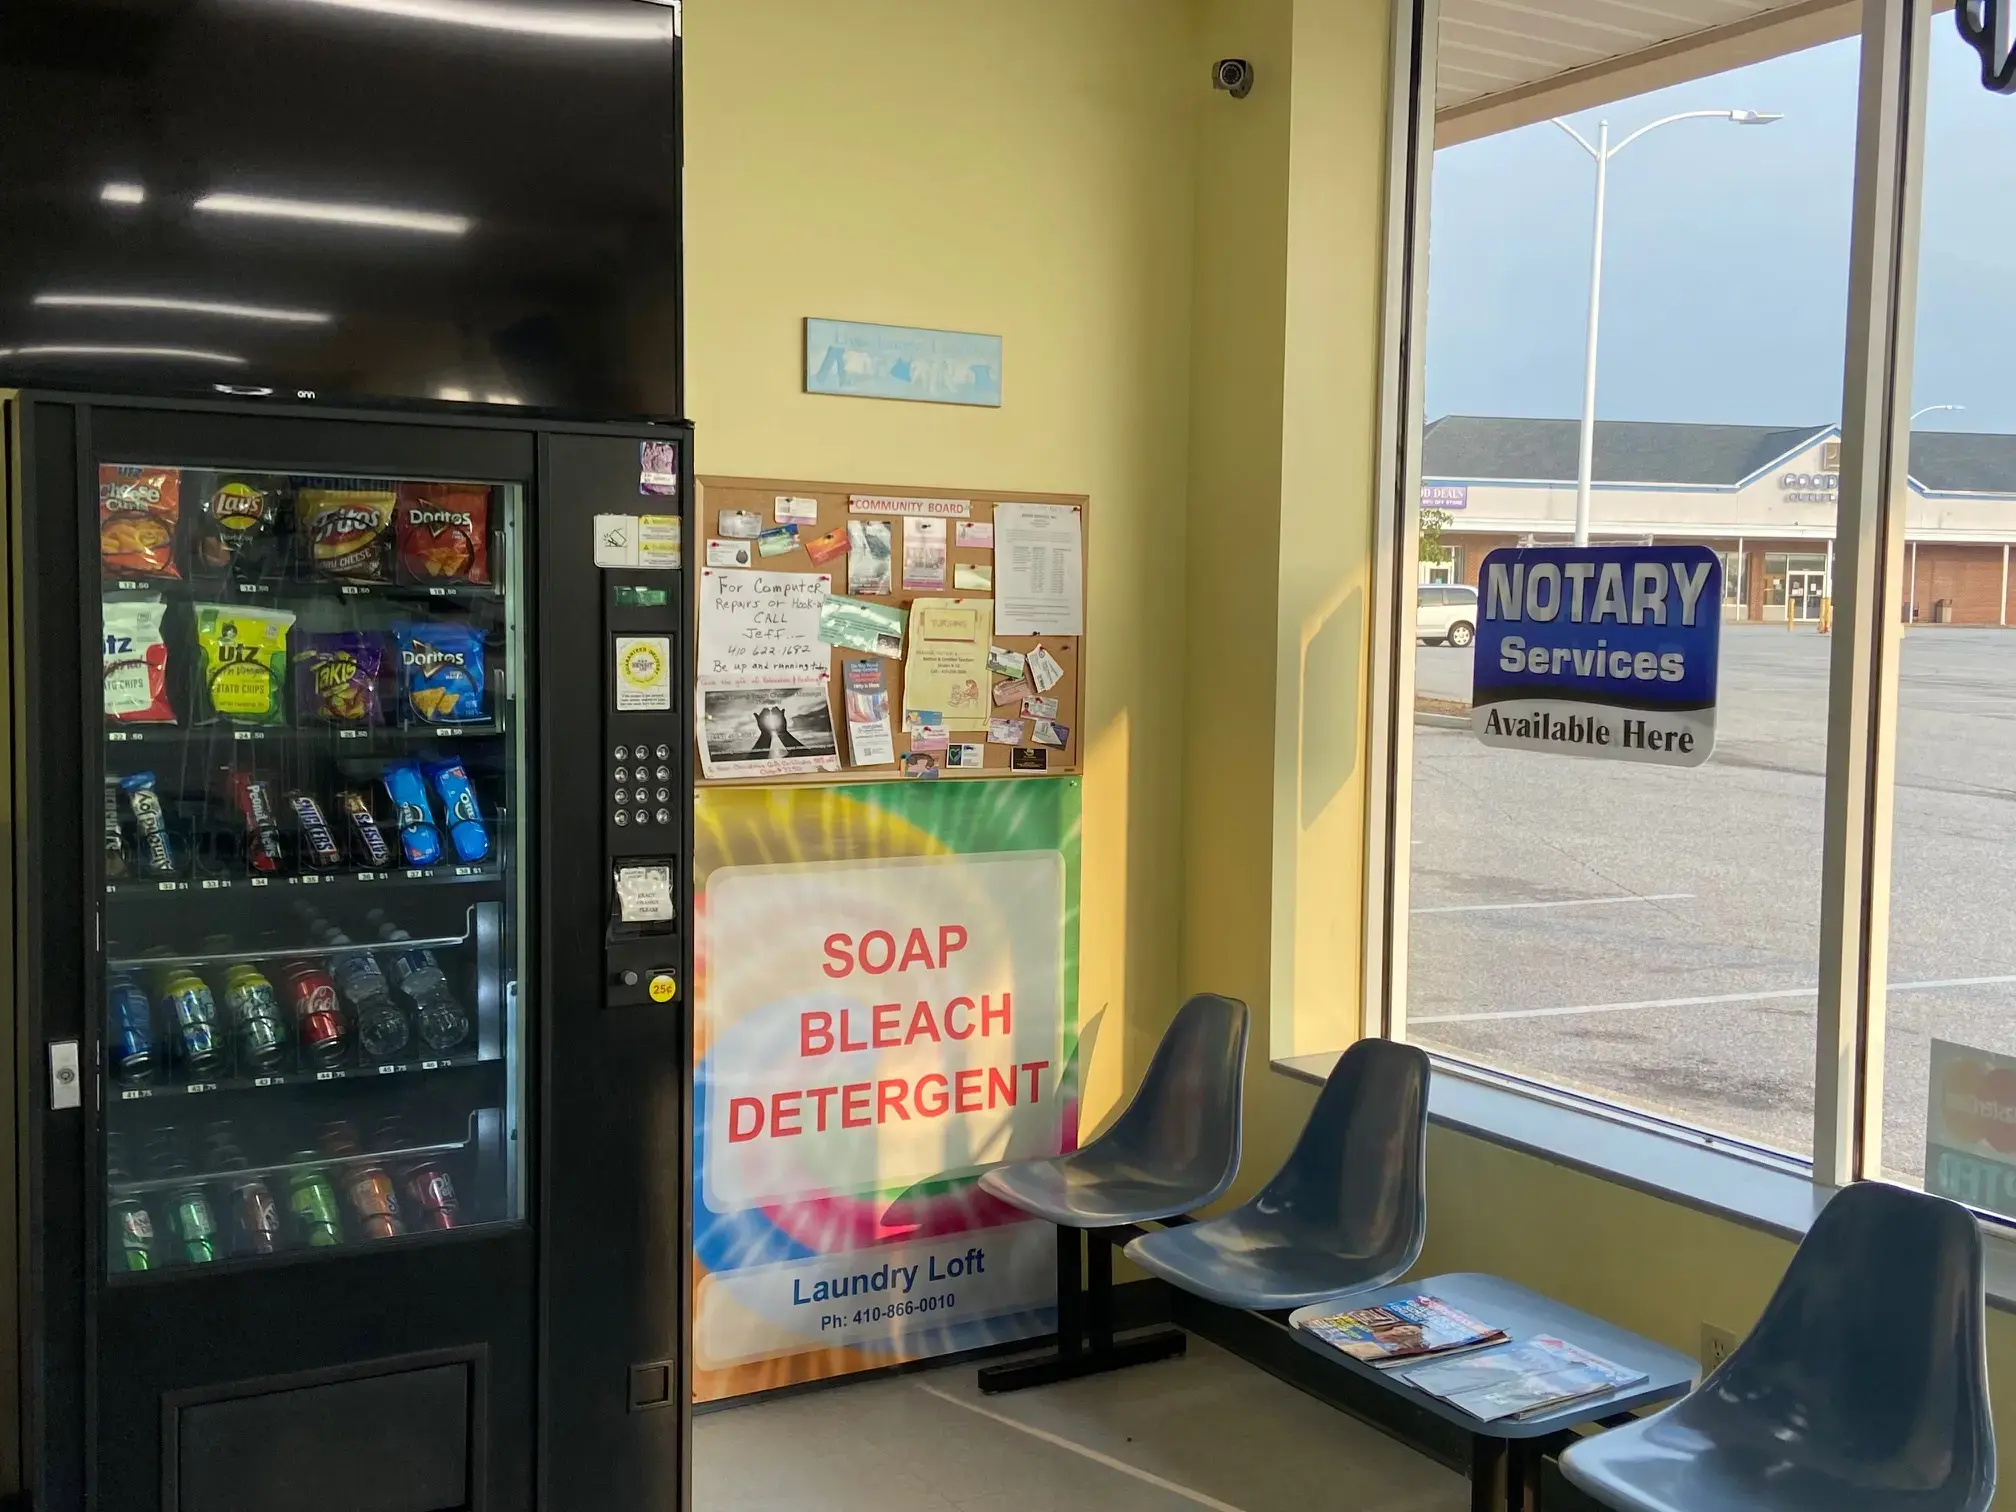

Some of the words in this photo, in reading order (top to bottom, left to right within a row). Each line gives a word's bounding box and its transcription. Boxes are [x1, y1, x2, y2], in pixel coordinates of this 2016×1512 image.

[1784, 473, 1838, 490] GOOD
[100, 483, 160, 503] Cheese
[1434, 488, 1464, 499] DEALS
[216, 494, 261, 516] Lay's
[855, 499, 923, 512] COMMUNITY
[928, 502, 964, 513] BOARD
[312, 508, 380, 543] Fritos
[409, 509, 471, 525] Doritos
[339, 547, 372, 567] CHEESE
[718, 576, 744, 595] For
[1486, 562, 1712, 626] NOTARY
[716, 598, 760, 613] Repairs
[768, 600, 785, 608] or
[753, 612, 788, 624] CALL
[102, 634, 133, 655] tz
[728, 646, 746, 657] 410
[402, 651, 464, 666] Doritos
[713, 660, 728, 673] Be
[734, 663, 747, 674] up
[752, 662, 769, 670] and
[773, 662, 809, 672] running
[1500, 636, 1685, 682] Services
[213, 683, 239, 694] OTATO
[242, 684, 265, 694] CHIPS
[1484, 708, 1610, 745] Available
[1622, 719, 1694, 753] Here
[137, 791, 158, 817] Joy
[247, 784, 268, 822] Peanut
[460, 792, 476, 820] ORE
[822, 925, 968, 979] SOAP
[653, 984, 673, 995] 25¢
[801, 993, 1011, 1057] BLEACH
[729, 1061, 1049, 1143] DETERGENT
[793, 1263, 918, 1305] Laundry
[929, 1248, 985, 1281] Loft
[821, 1314, 847, 1331] Ph:
[853, 1293, 955, 1325] 410-866-0010
